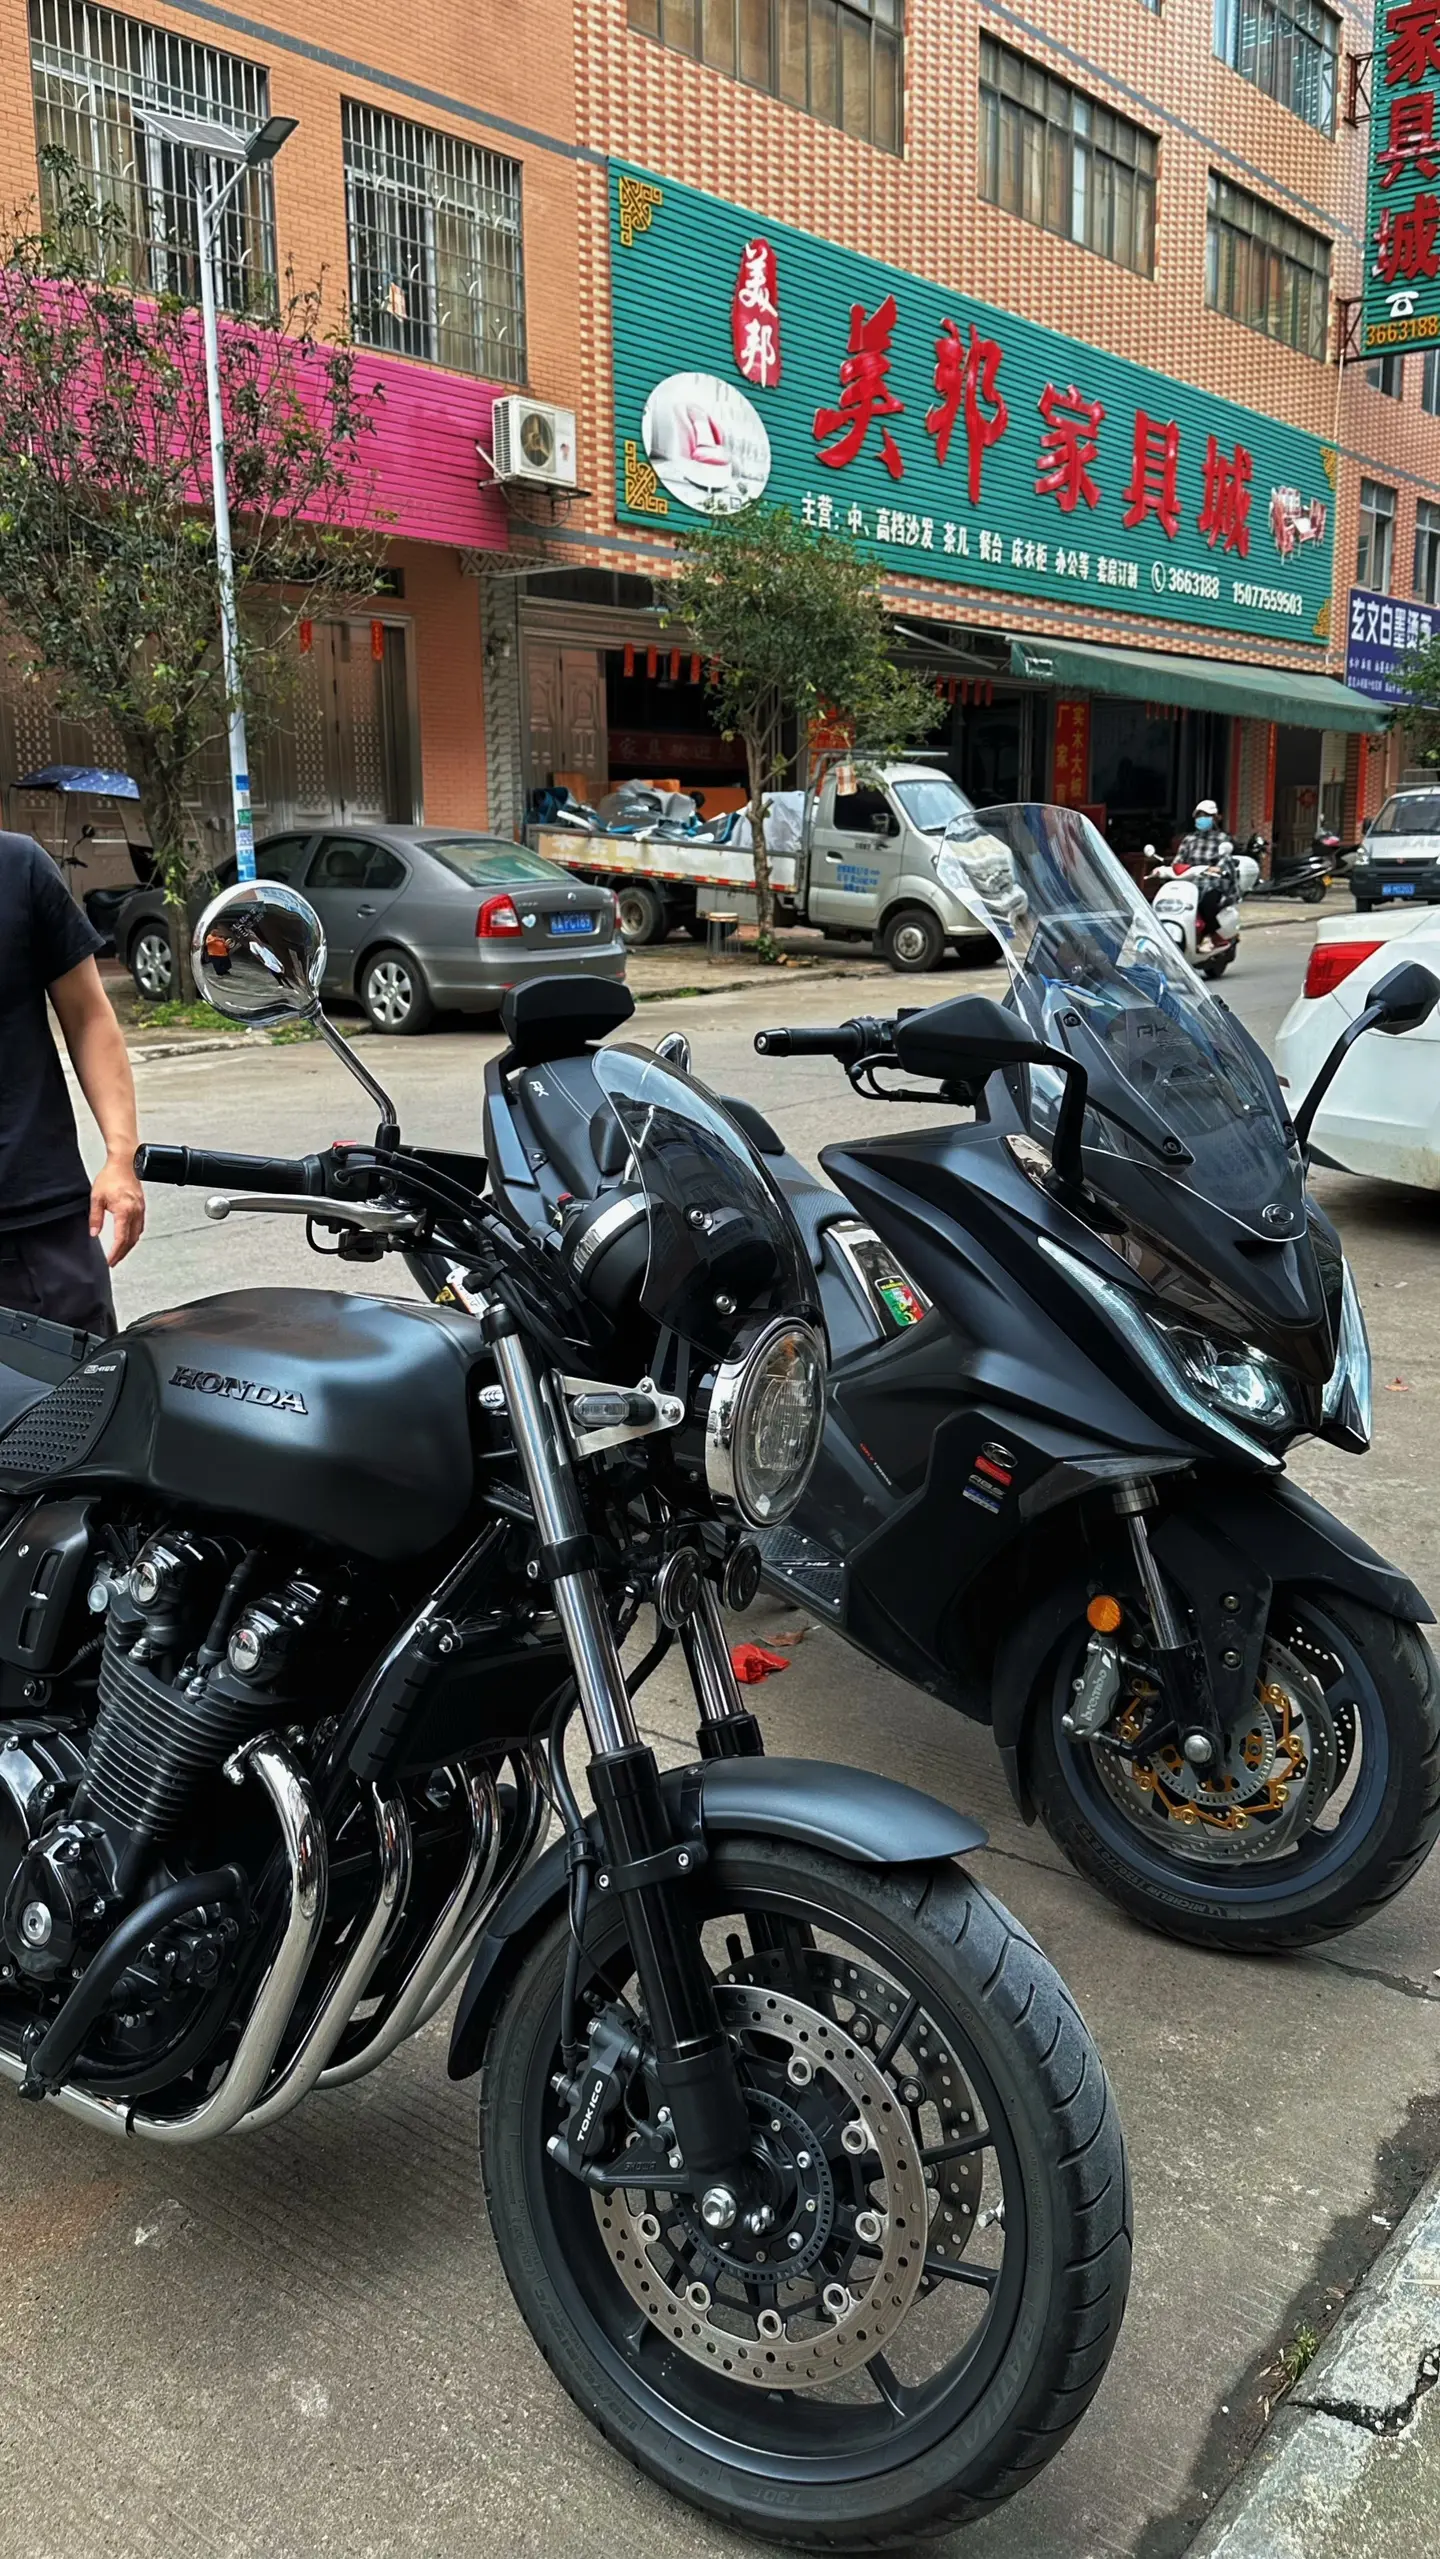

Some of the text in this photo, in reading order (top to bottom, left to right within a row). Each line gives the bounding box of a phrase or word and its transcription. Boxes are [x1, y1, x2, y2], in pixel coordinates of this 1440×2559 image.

[1372, 0, 1440, 285] 家具城
[738, 242, 778, 389] 美邦
[1366, 315, 1439, 346] 3663188
[811, 293, 1256, 560] 美邦家具城
[943, 521, 970, 556] 茶几
[979, 529, 1003, 564] 餐台
[1168, 567, 1220, 600] 3663188
[168, 1366, 309, 1415] HONDA
[1081, 1669, 1107, 1721] brembo
[576, 2080, 603, 2141] TOKICO
